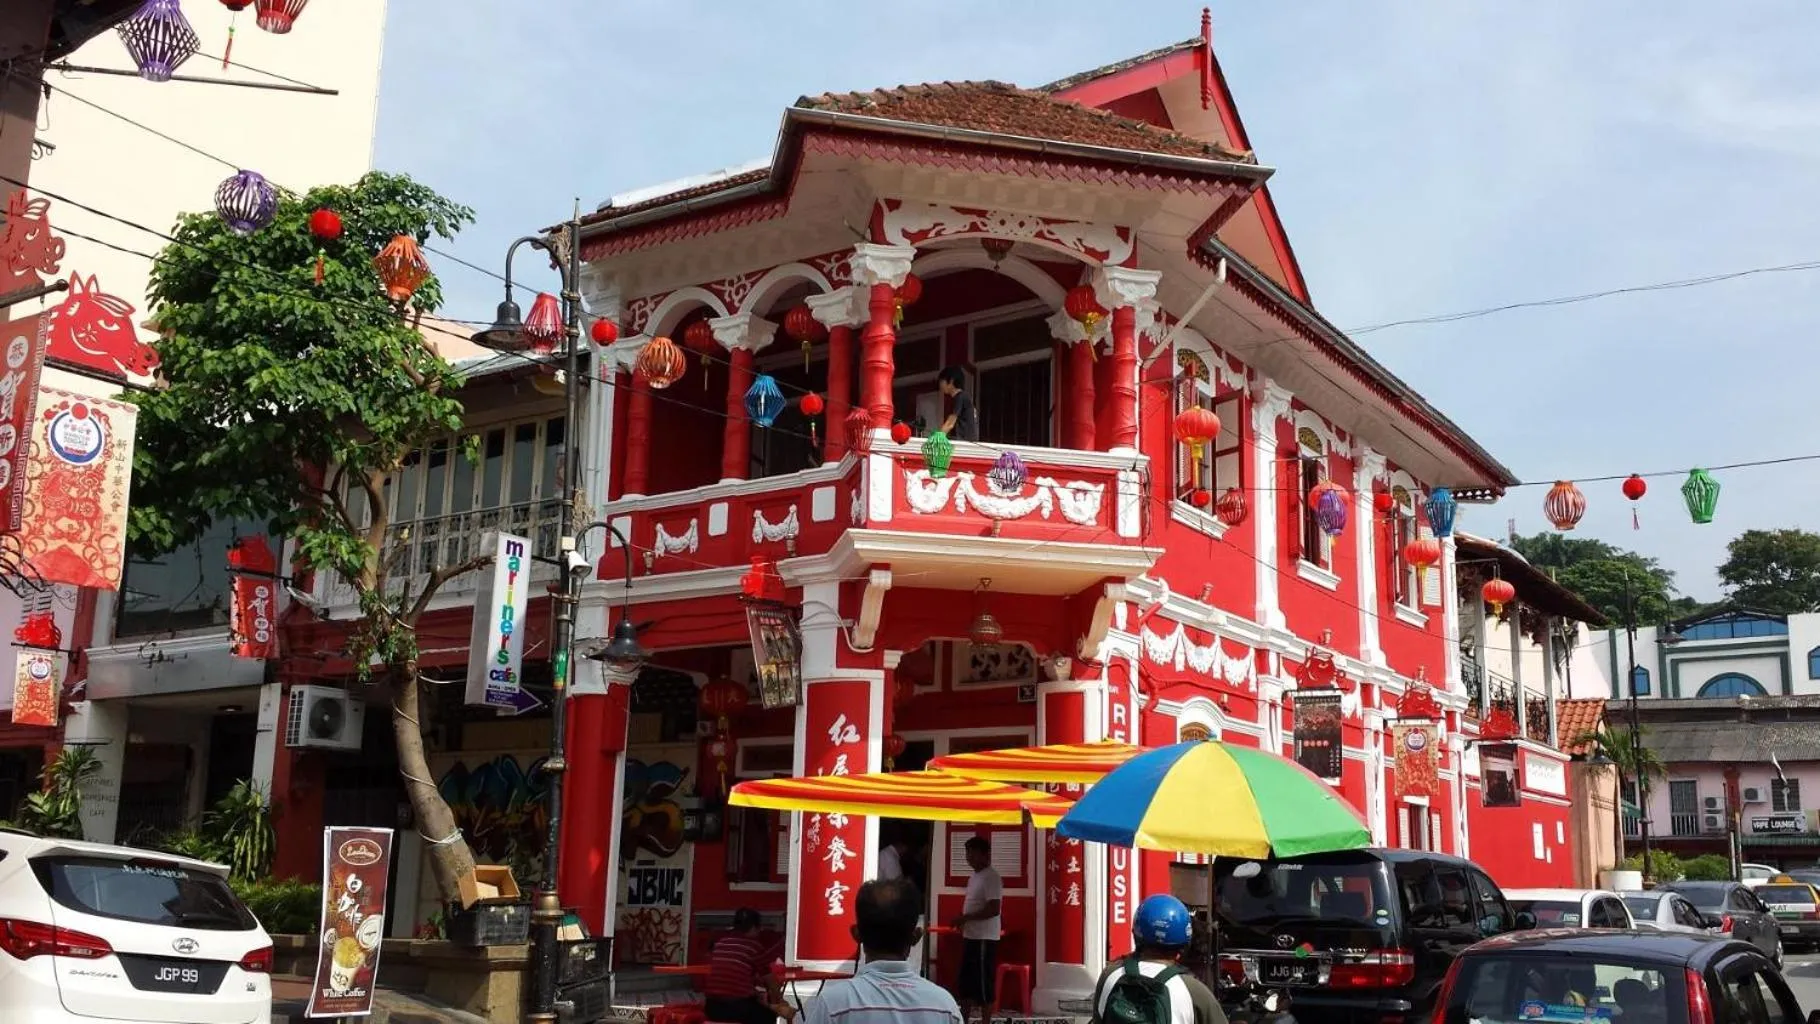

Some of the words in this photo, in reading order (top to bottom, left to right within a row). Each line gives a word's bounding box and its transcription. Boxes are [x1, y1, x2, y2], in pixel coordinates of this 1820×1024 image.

[497, 539, 524, 665] mariners
[489, 667, 517, 684] cafe
[154, 967, 180, 982] JGP
[182, 969, 198, 983] 99
[322, 988, 343, 998] White
[343, 987, 366, 997] Coffee
